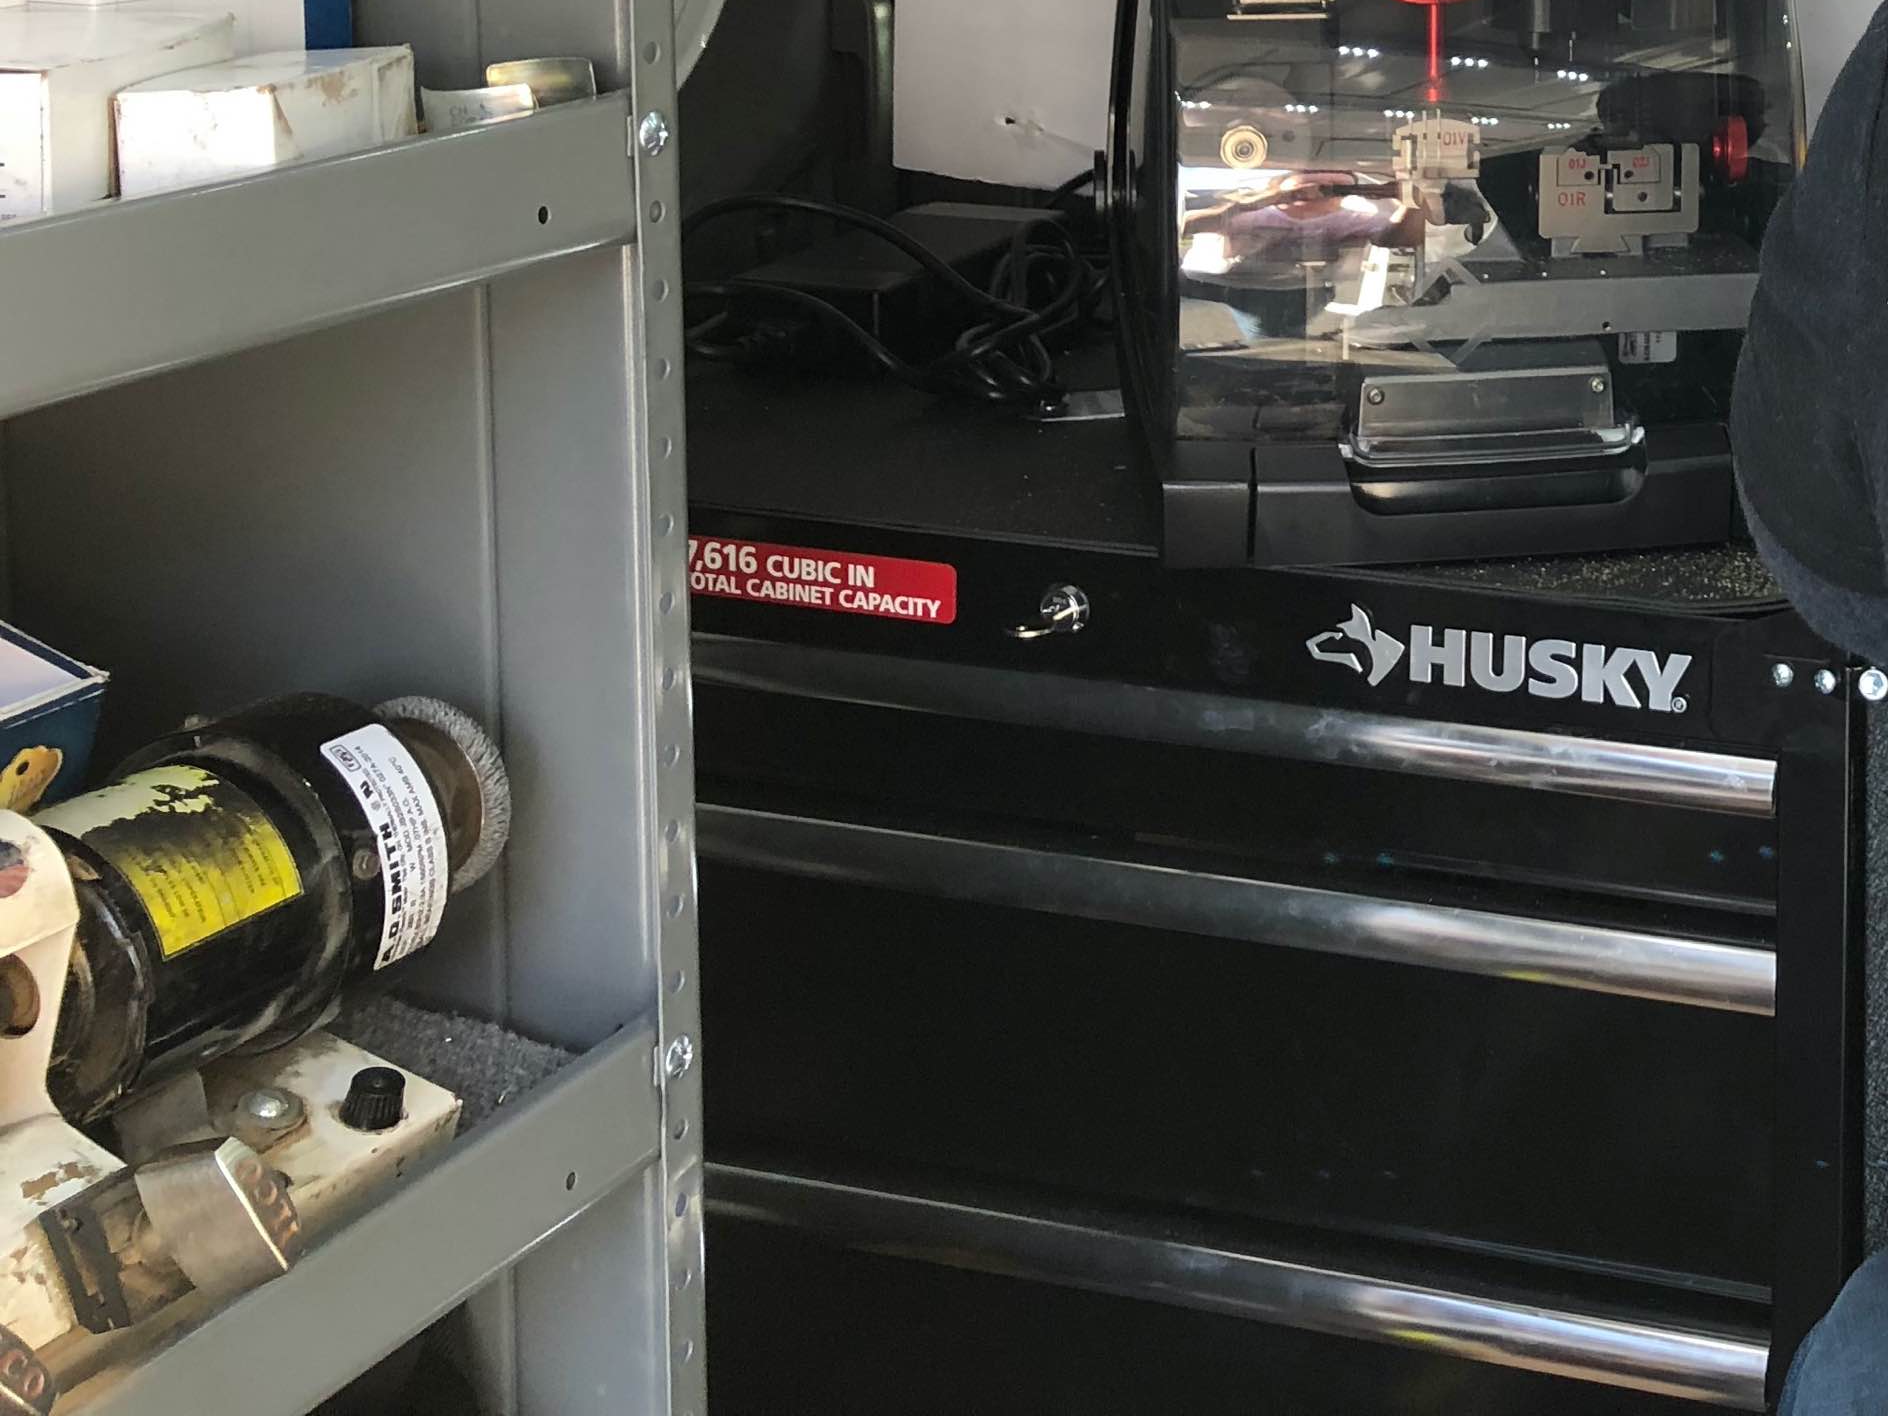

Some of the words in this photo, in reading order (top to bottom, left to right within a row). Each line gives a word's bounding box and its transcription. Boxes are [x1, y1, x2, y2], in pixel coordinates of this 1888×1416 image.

[766, 555, 841, 584] CUBIC
[847, 563, 875, 588] IN
[690, 572, 742, 595] OTAL
[746, 578, 834, 607] CABINET
[838, 589, 942, 619] CAPACITY
